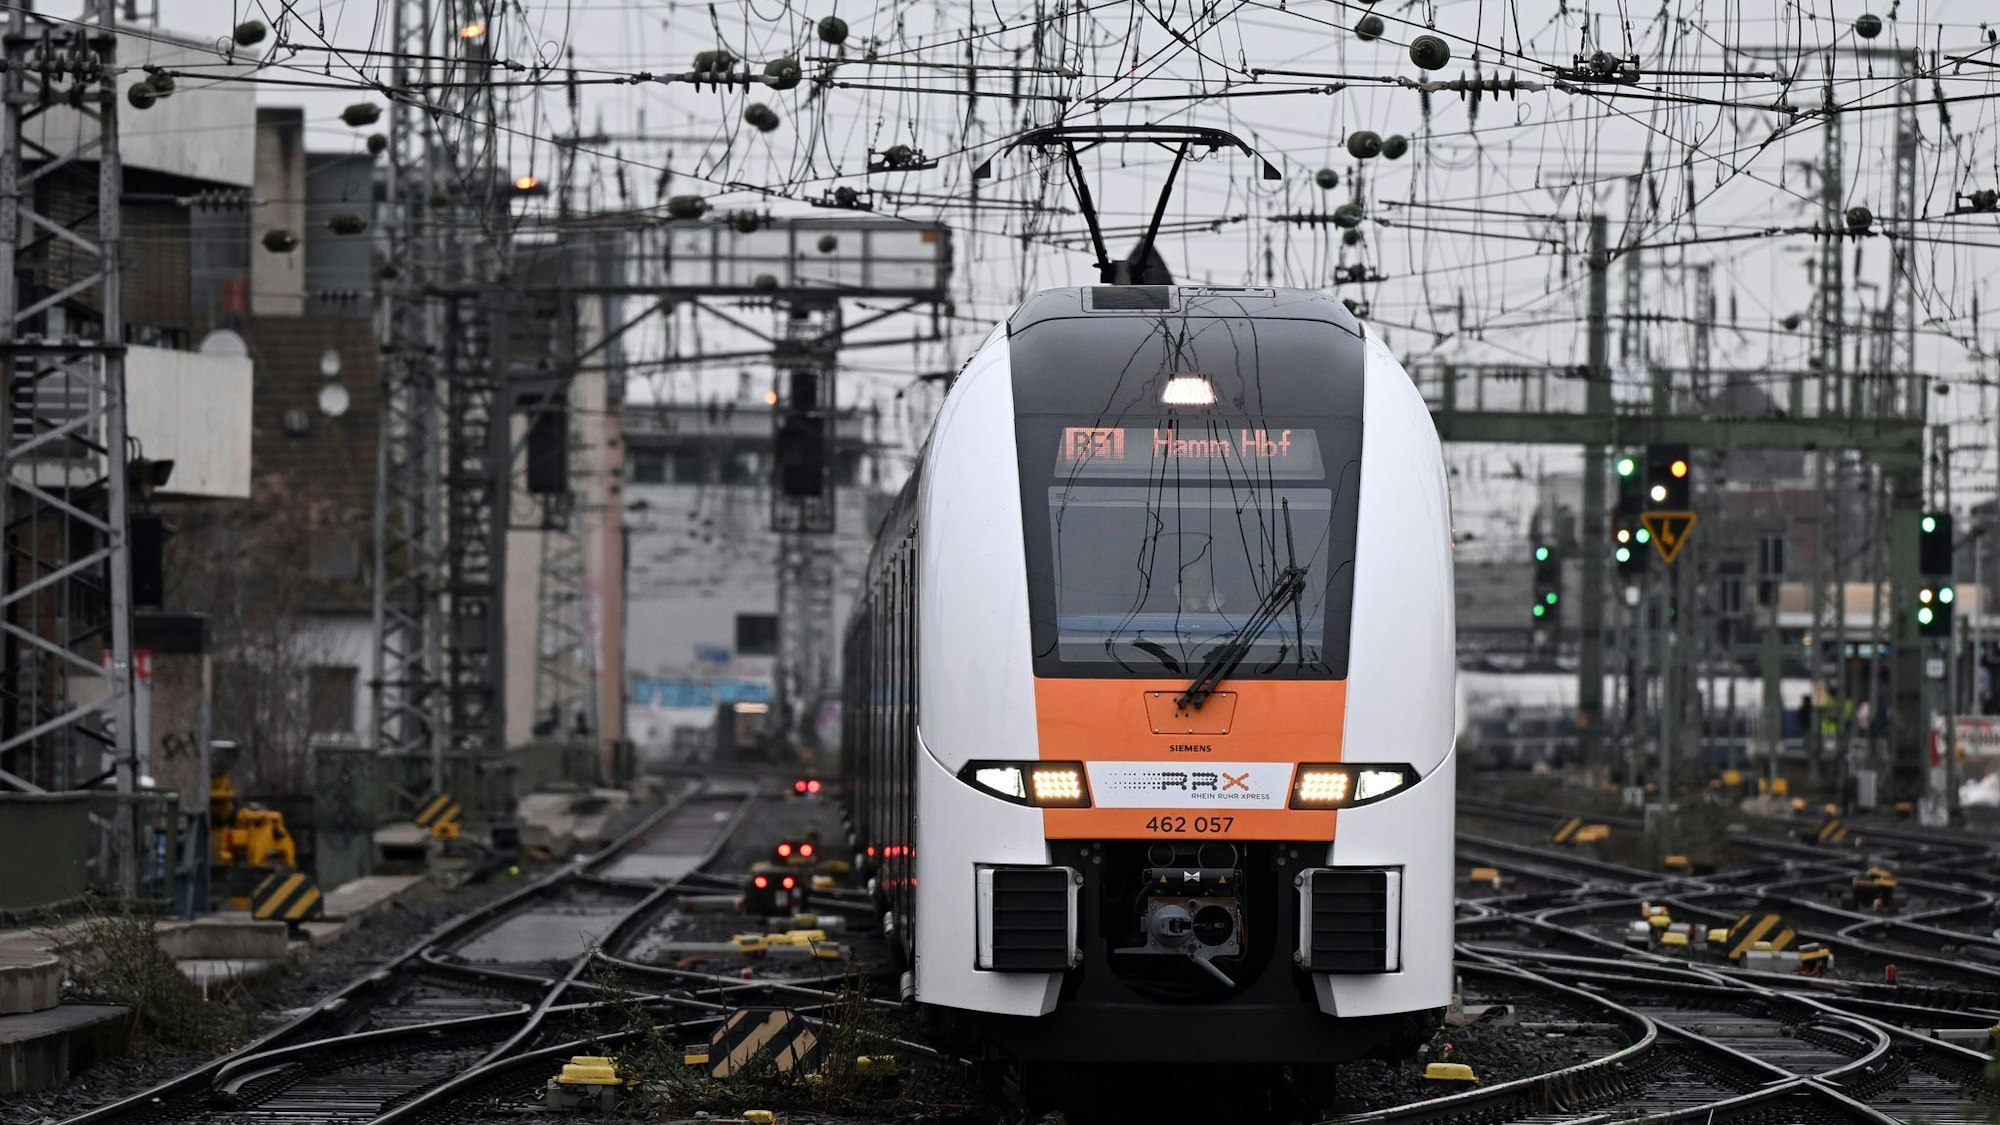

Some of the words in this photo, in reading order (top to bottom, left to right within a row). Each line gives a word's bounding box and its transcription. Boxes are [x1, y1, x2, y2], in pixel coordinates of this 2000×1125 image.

[1153, 428, 1230, 458] Hamm
[1241, 428, 1291, 458] Hbf
[1169, 744, 1212, 753] SIEMENS
[1161, 772, 1250, 792] RRX
[1191, 792, 1216, 800] RHEIN
[1241, 793, 1271, 801] XPRESS
[1145, 816, 1187, 833] 462
[1193, 817, 1235, 833] 057
